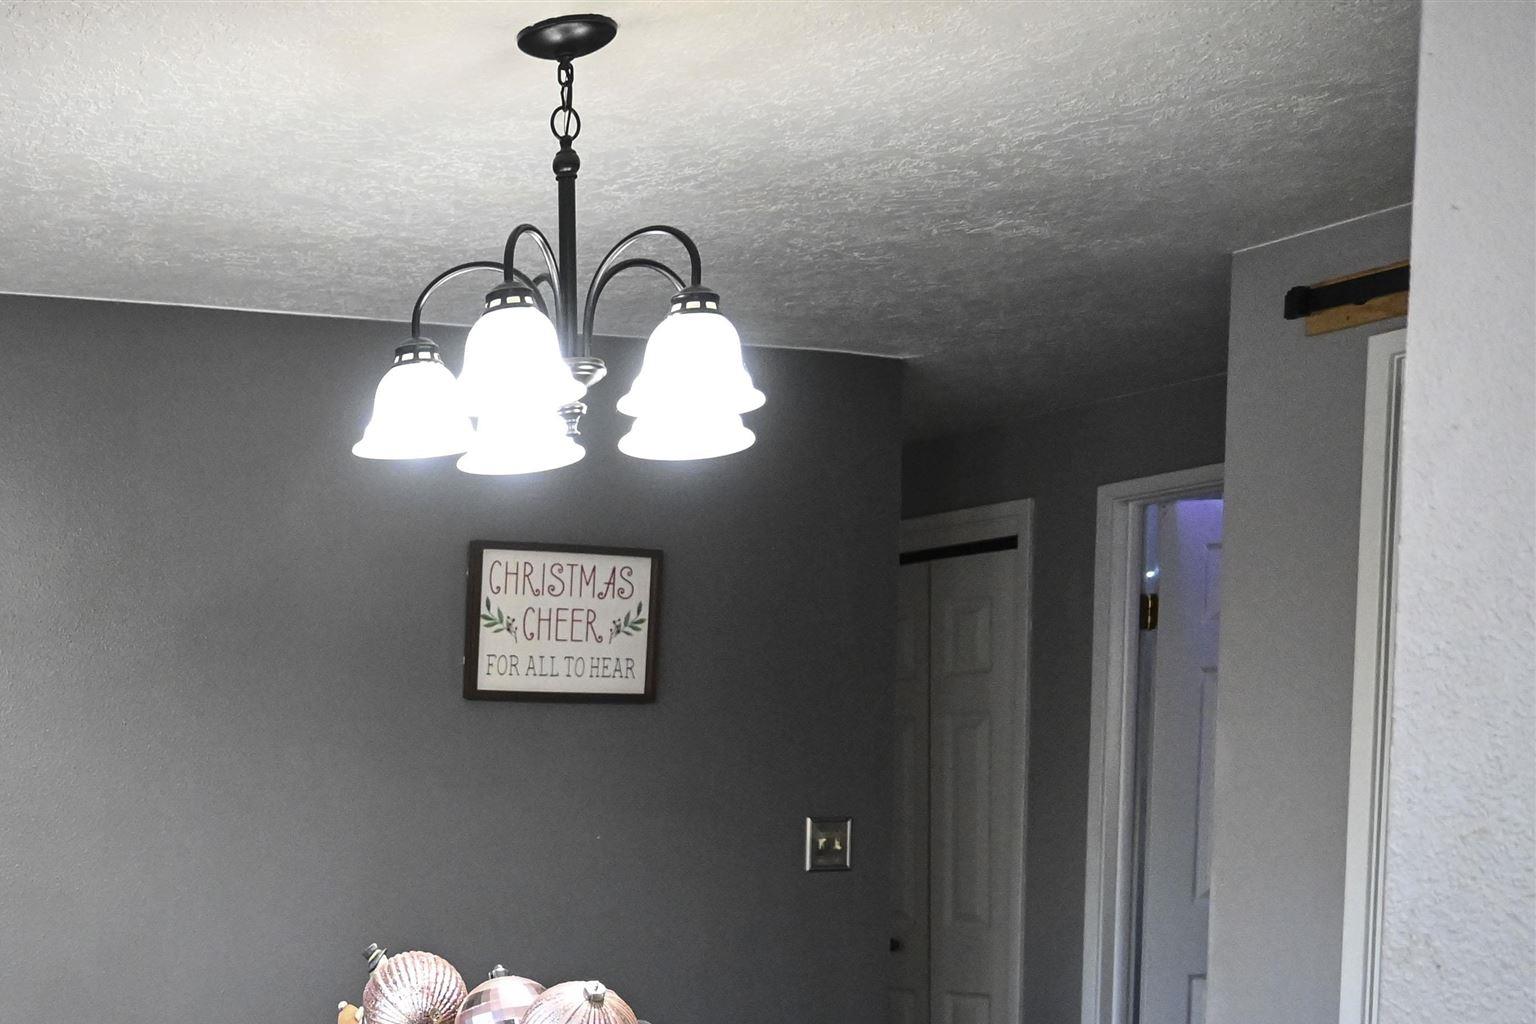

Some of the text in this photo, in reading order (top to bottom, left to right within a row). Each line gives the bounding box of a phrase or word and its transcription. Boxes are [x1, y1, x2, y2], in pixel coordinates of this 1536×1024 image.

[489, 559, 635, 600] CHRISTMAS
[522, 606, 604, 644] CHEER
[486, 653, 636, 680] FOR ALL TO HEAR
